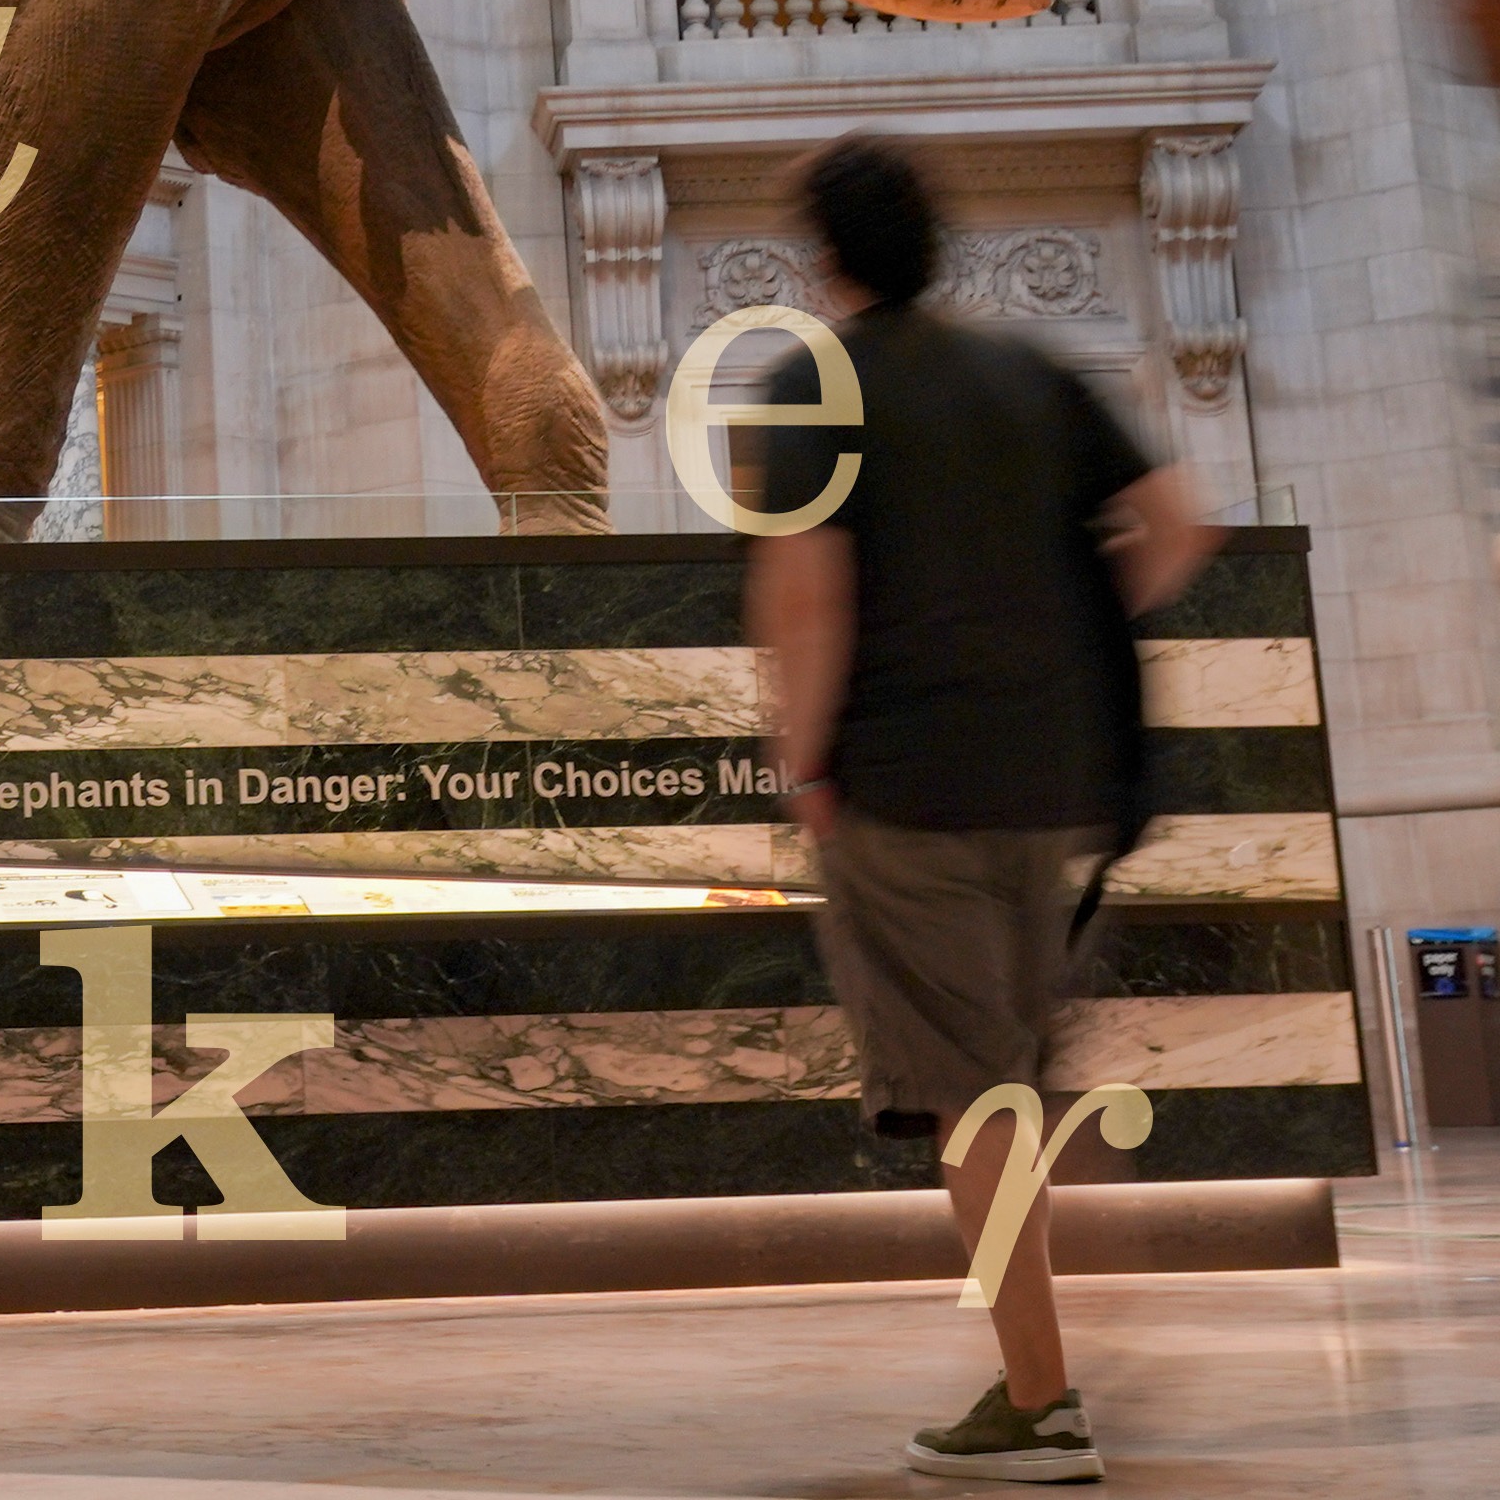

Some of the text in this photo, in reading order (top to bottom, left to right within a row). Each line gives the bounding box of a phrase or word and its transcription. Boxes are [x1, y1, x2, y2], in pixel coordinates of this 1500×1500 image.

[185, 768, 222, 806] in
[238, 766, 406, 812] Danger:
[420, 763, 520, 801] Your
[533, 757, 705, 798] Choices
